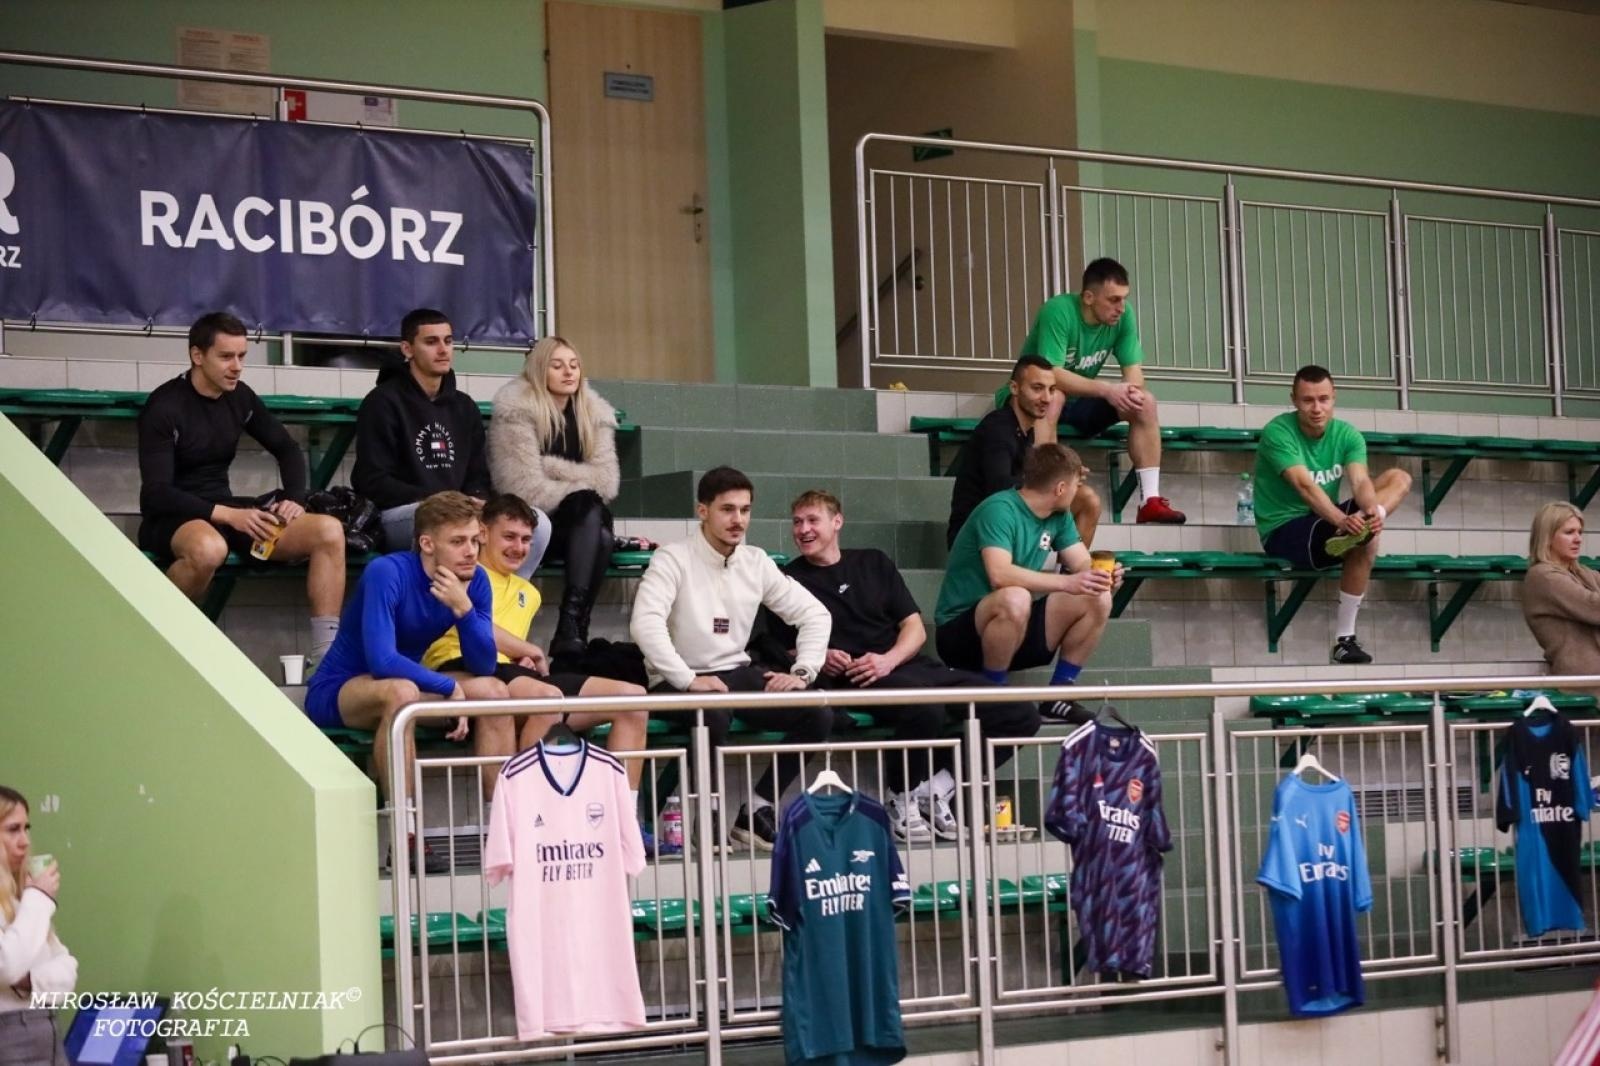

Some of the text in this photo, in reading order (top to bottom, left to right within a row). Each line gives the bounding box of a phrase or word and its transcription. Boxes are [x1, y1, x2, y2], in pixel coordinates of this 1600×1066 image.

[140, 184, 465, 266] RACIBÓRZ
[536, 840, 604, 864] Emiraes
[542, 864, 561, 882] FLY
